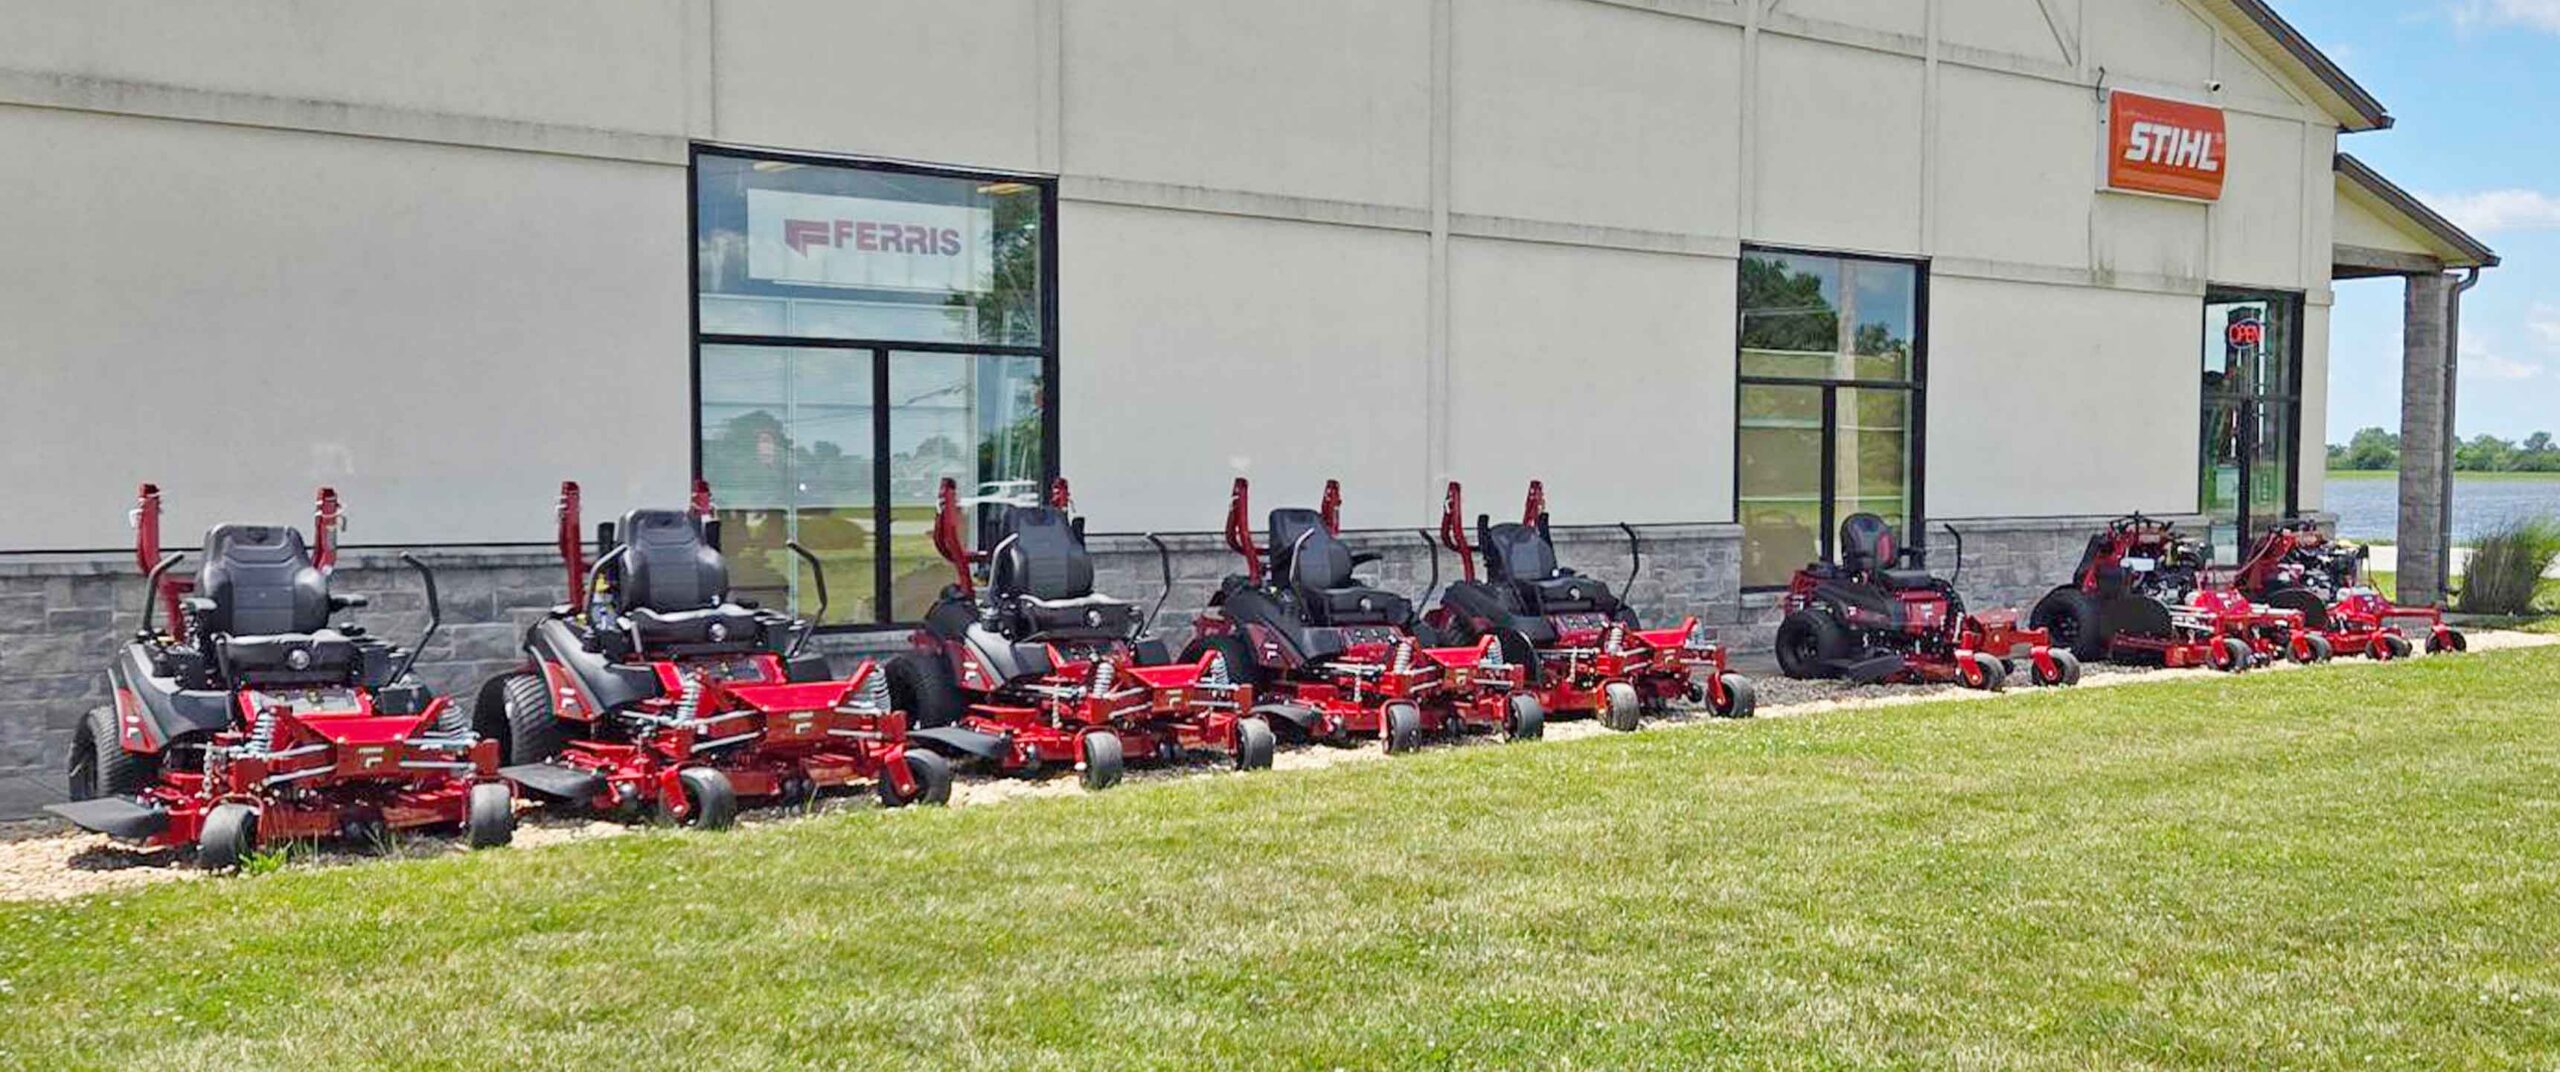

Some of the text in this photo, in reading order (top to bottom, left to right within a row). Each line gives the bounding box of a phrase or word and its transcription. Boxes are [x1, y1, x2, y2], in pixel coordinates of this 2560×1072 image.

[2124, 120, 2218, 172] STIHL
[834, 219, 961, 257] FERRIS
[2229, 324, 2260, 345] OPEN
